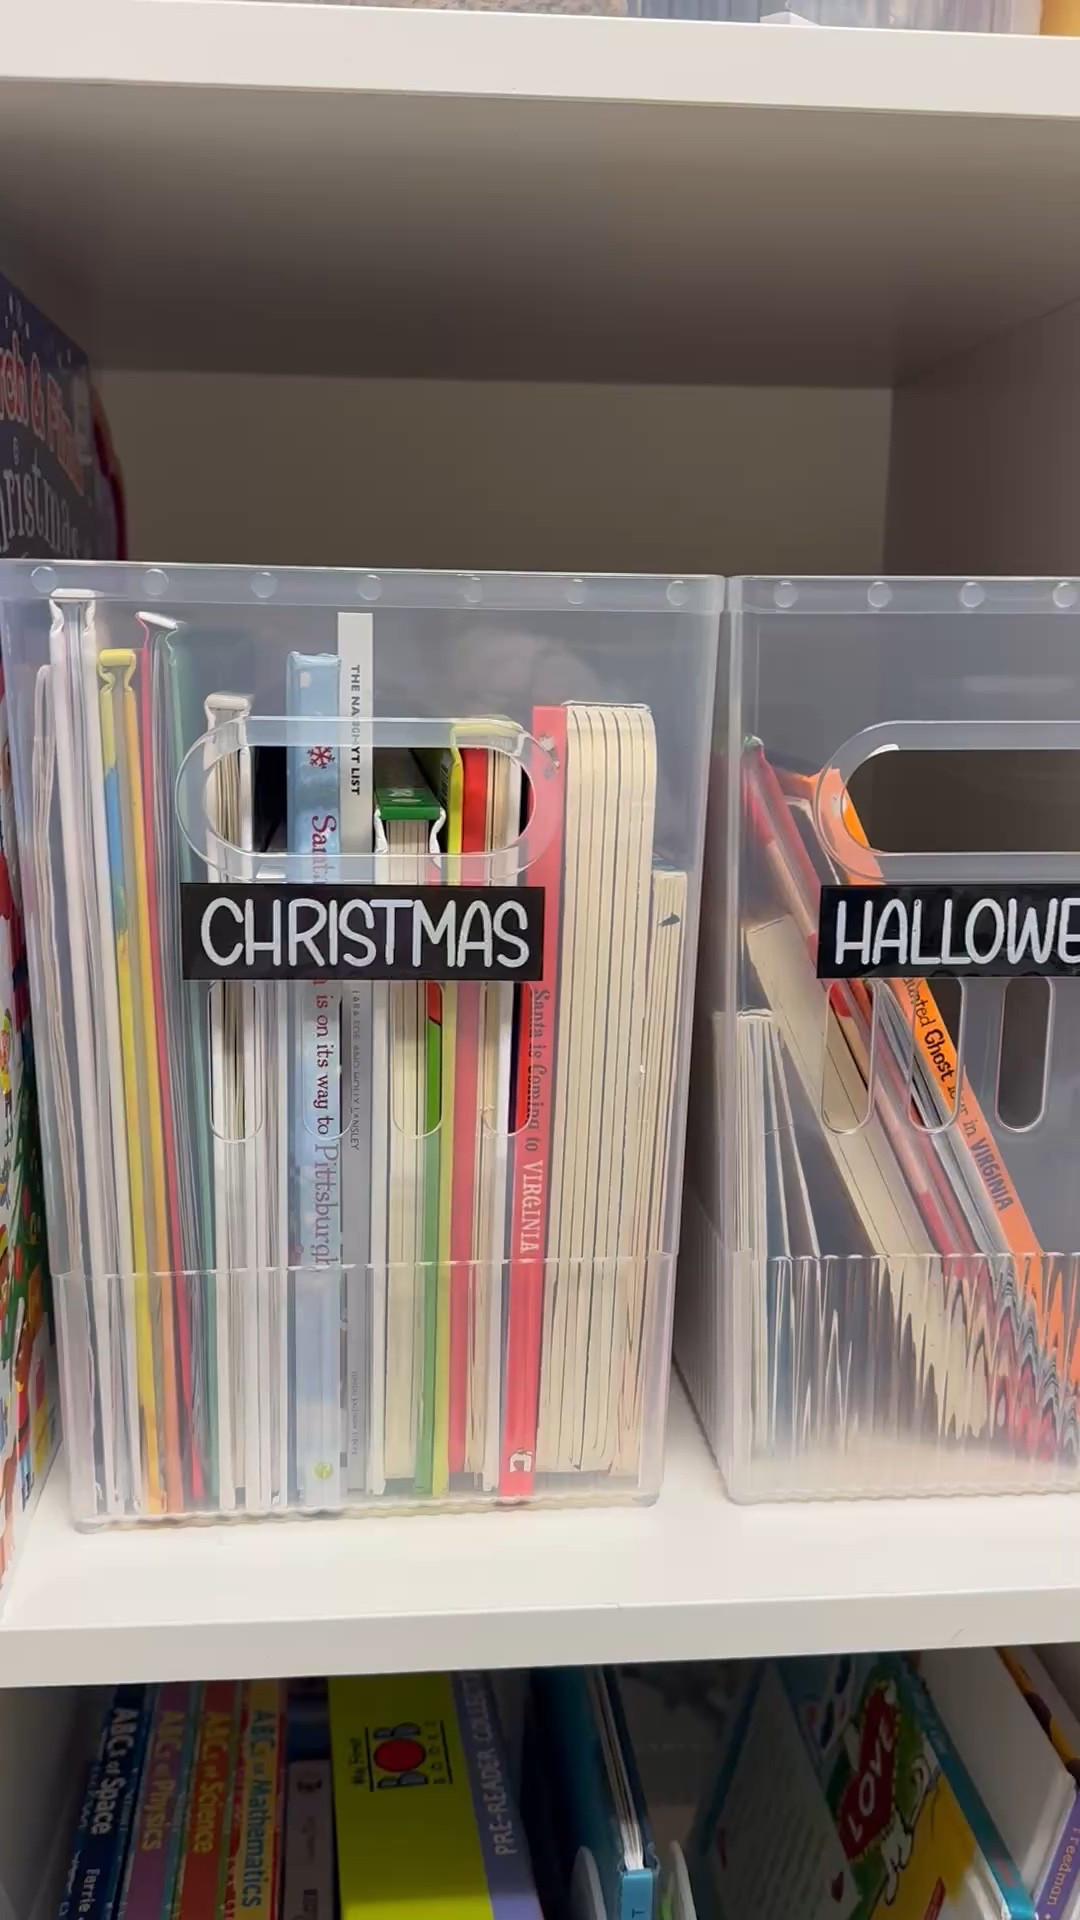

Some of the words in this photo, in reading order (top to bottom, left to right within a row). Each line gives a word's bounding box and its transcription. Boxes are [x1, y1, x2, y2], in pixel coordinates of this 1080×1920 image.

[351, 665, 361, 691] THE
[351, 768, 361, 795] LIST
[201, 897, 530, 967] CHRISTMAS
[316, 995, 334, 1009] is
[530, 989, 549, 1038] Santa
[316, 1015, 329, 1038] on
[316, 1045, 334, 1068] its
[529, 1045, 547, 1058] is
[313, 1075, 329, 1110] way
[526, 1064, 547, 1130] Coming
[317, 1117, 334, 1135] to
[350, 1107, 360, 1150] LANSLEY
[924, 1028, 955, 1081] Ghost
[962, 1117, 978, 1138] in
[971, 1136, 1014, 1210] VIRGINIA
[524, 1137, 542, 1152] to
[520, 1160, 543, 1254] VIRGINIA
[105, 1760, 120, 1775] of
[847, 1716, 894, 1842] LOVE
[91, 1776, 126, 1835] Space
[141, 1779, 176, 1850] Physics
[192, 1781, 224, 1853] Science
[477, 1749, 517, 1856] PRE-READER
[242, 1779, 273, 1907] Mathematics
